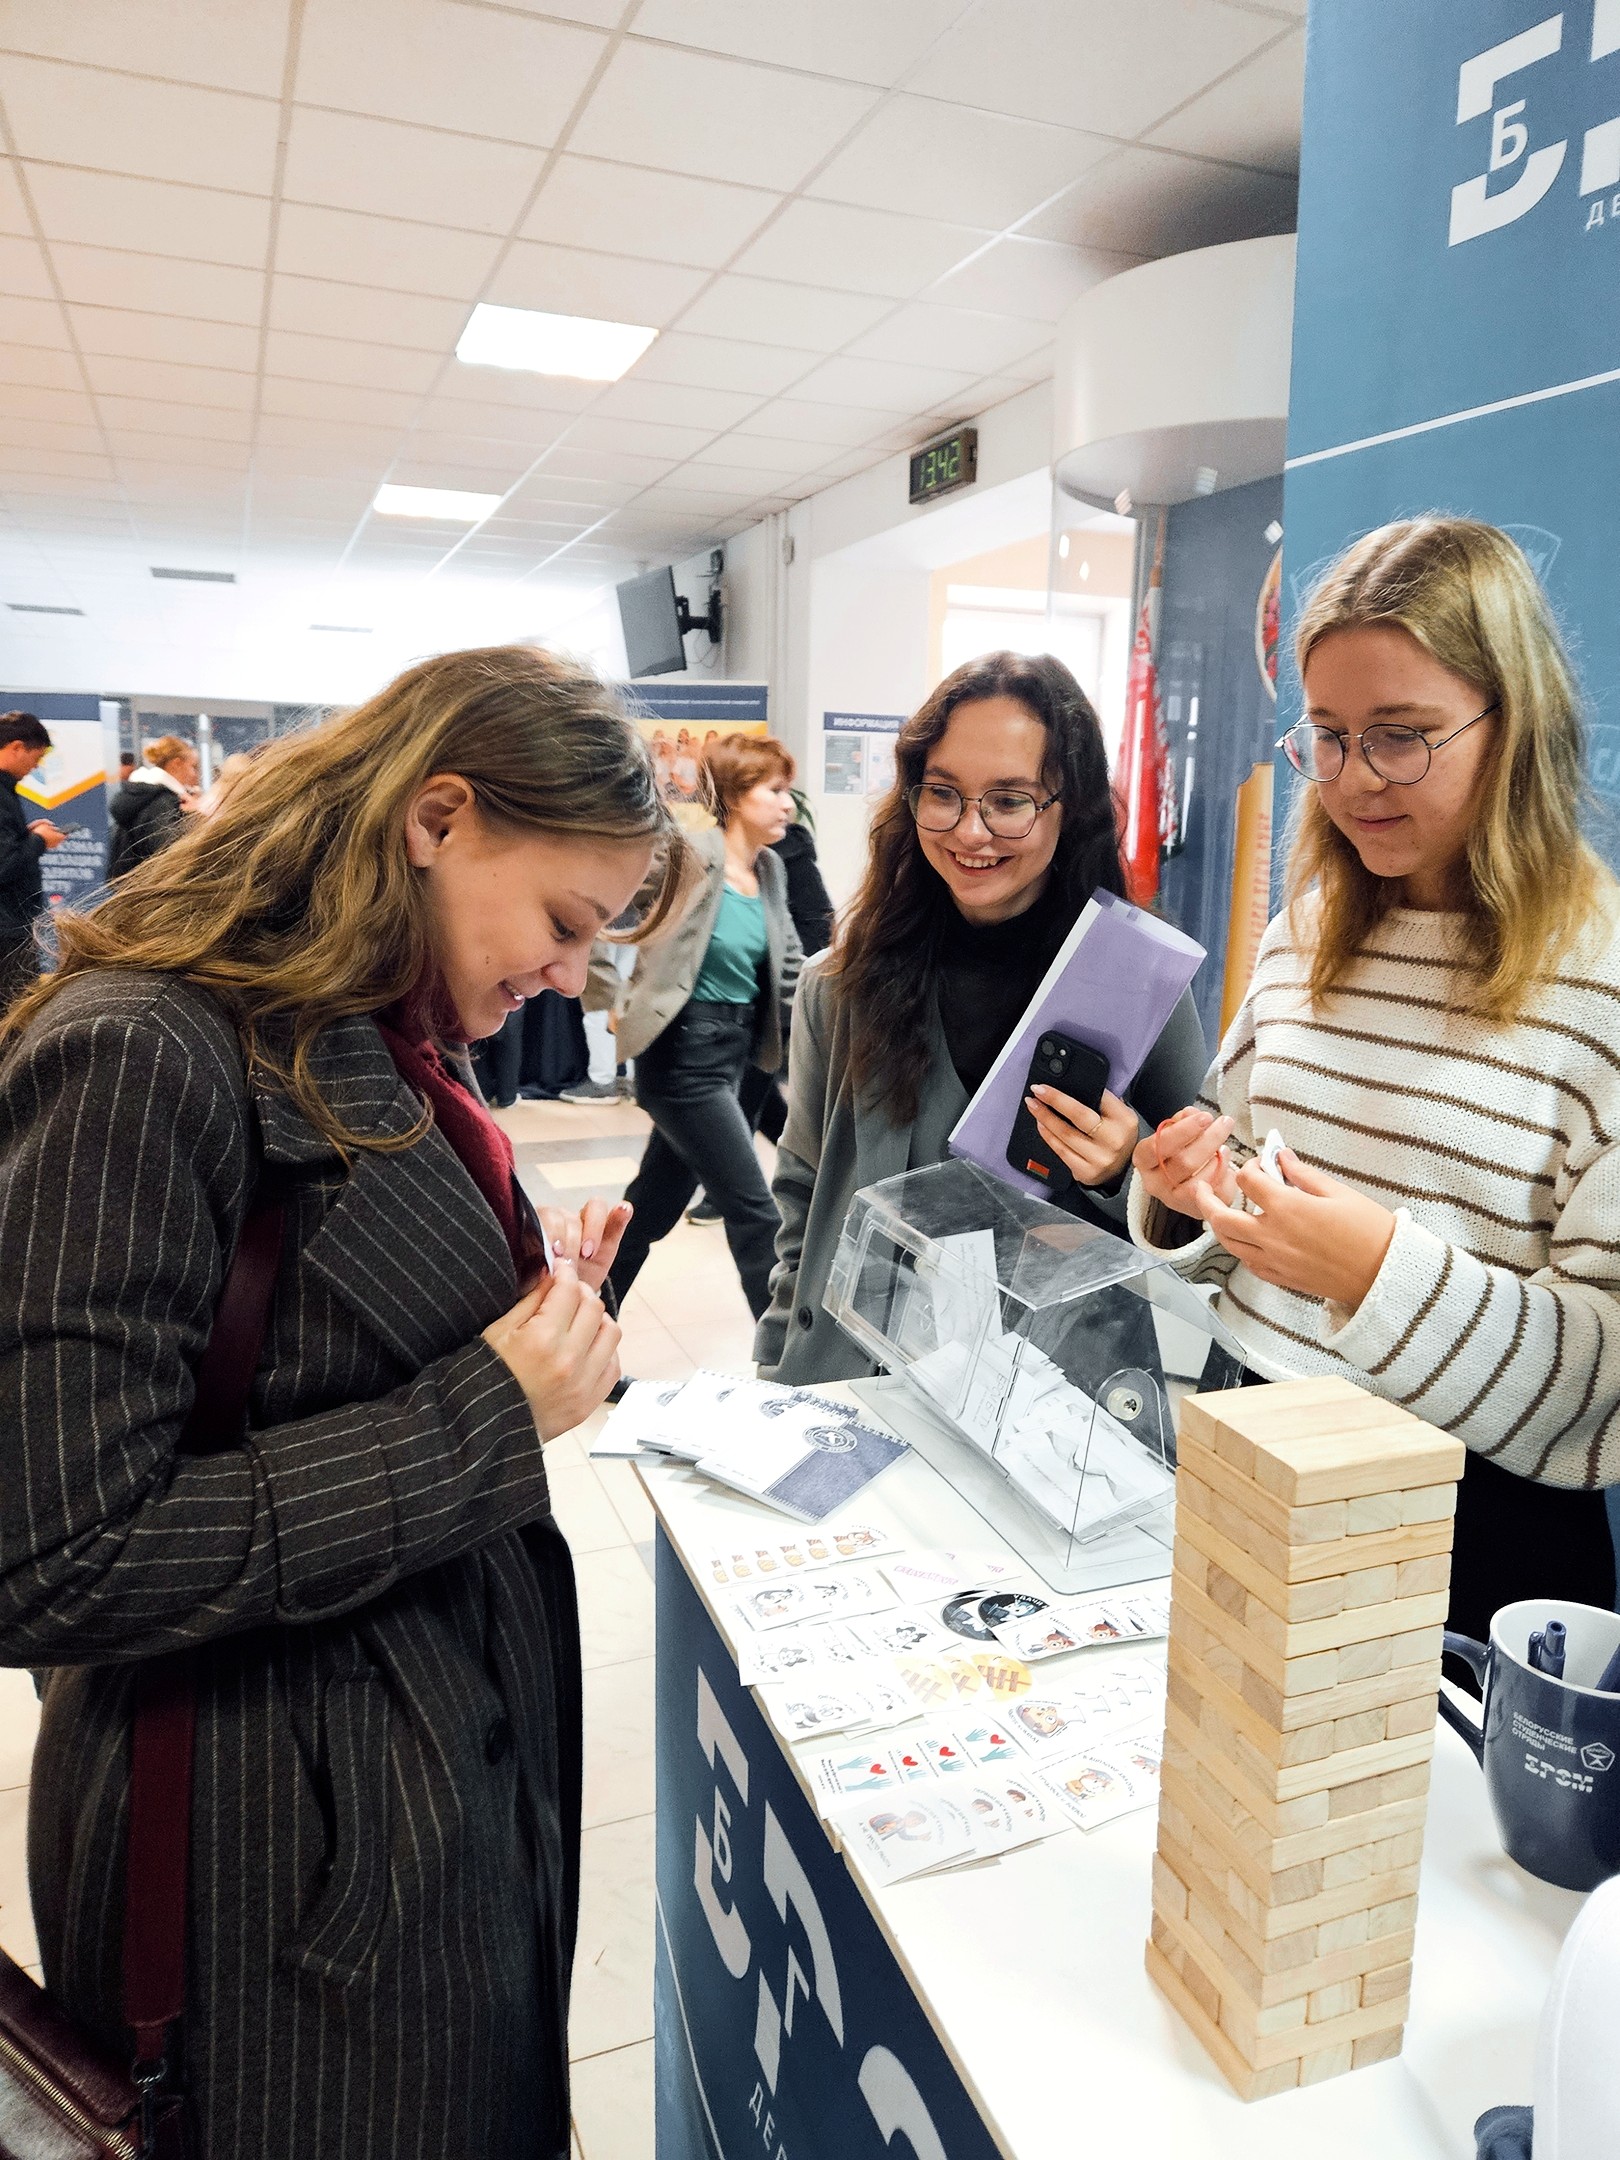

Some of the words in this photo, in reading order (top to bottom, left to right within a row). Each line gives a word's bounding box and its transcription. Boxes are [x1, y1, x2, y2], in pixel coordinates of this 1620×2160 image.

[1511, 1727, 1546, 1751] ОТРЯДЫ
[1512, 1719, 1578, 1754] СТУДЕНЧЕСКИЕ
[1513, 1711, 1574, 1745] БЕЛОРУССКИЕ
